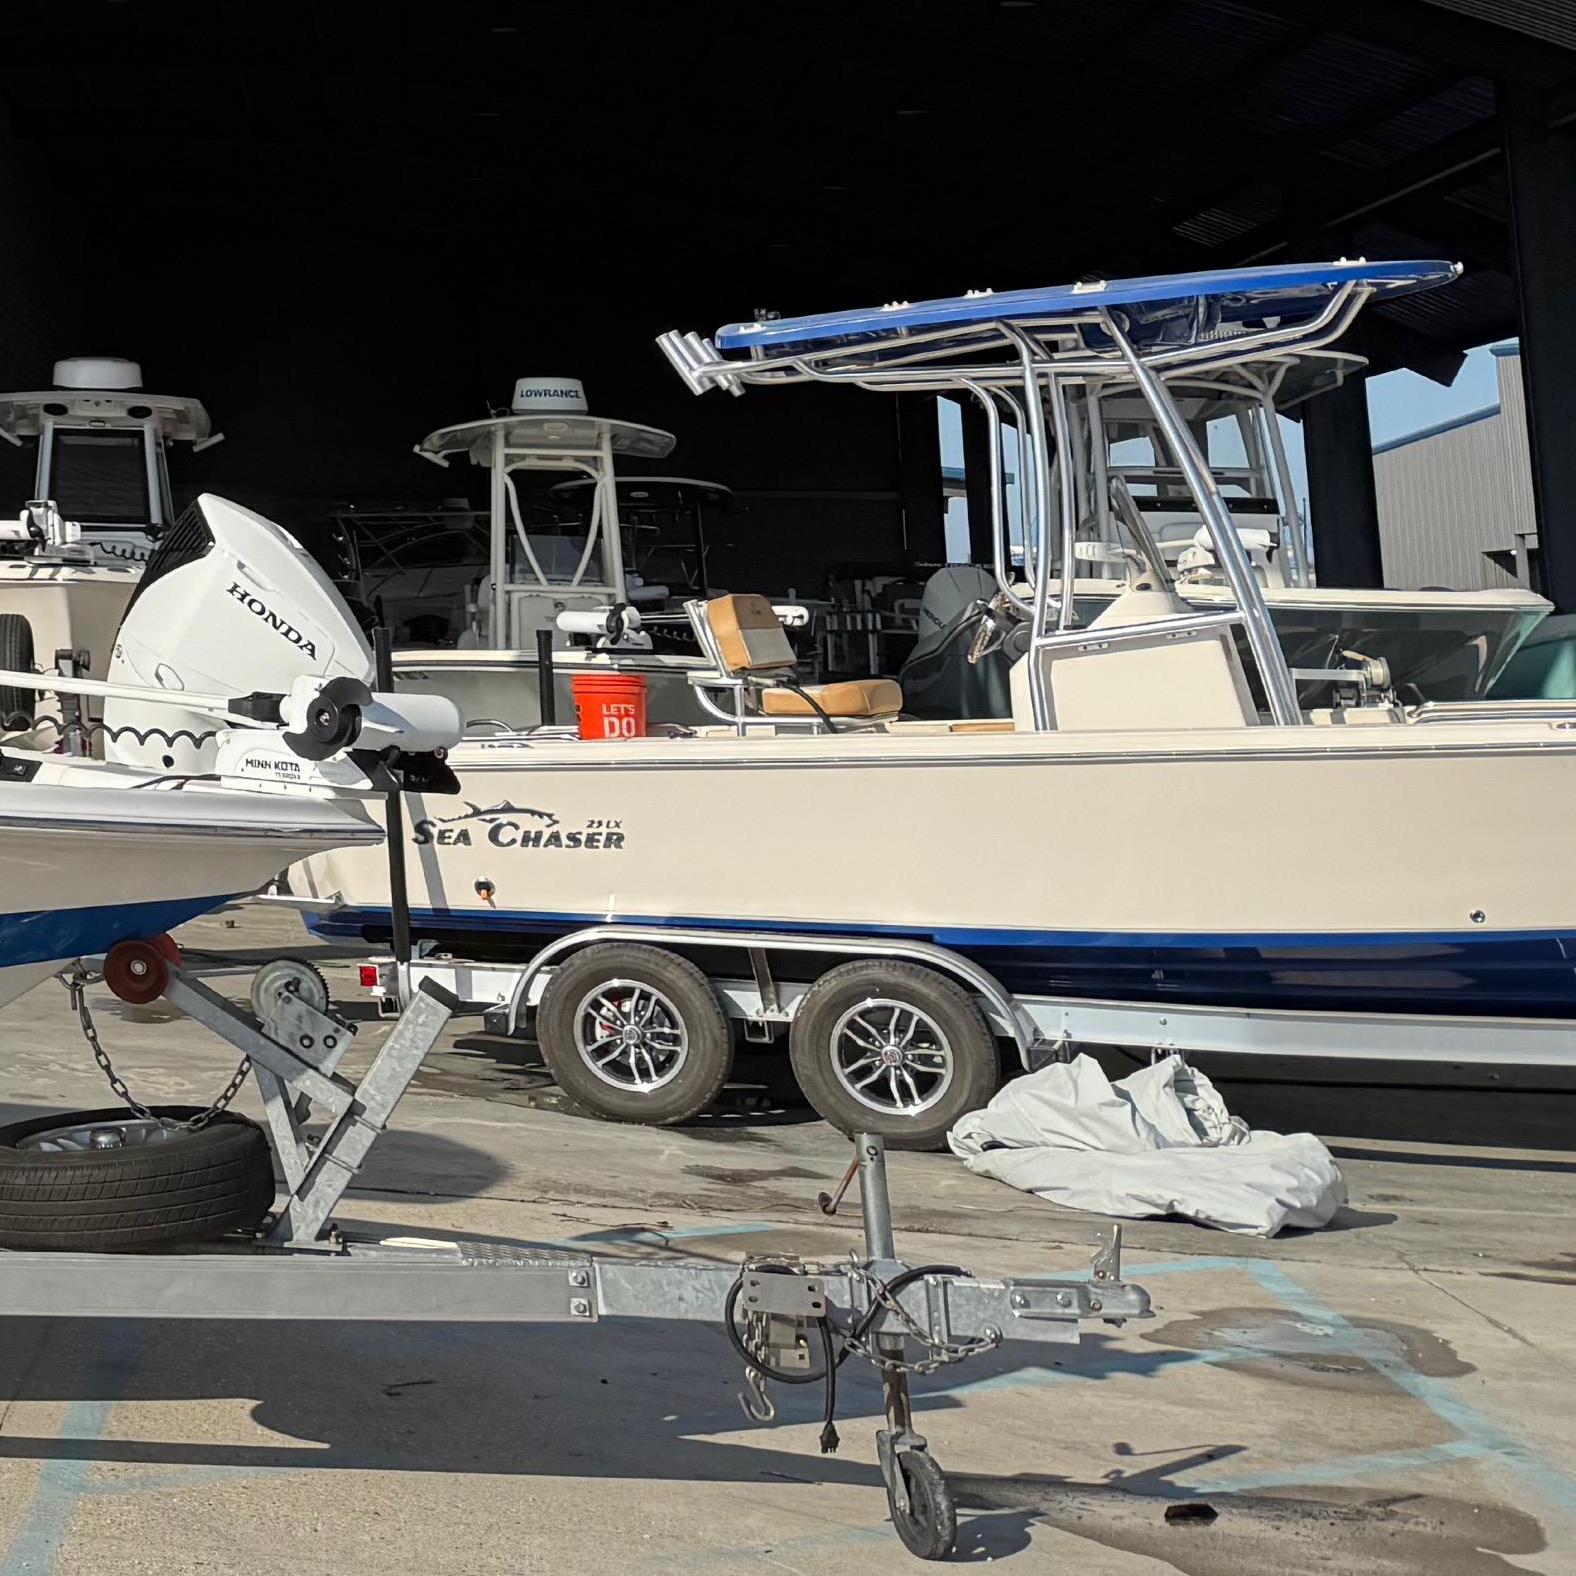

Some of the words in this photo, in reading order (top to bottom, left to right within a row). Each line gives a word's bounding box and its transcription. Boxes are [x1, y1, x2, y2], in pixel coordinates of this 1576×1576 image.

[520, 389, 582, 399] LOWRANCE
[226, 581, 317, 661] HONDA
[602, 703, 635, 715] LET'S
[603, 717, 636, 738] DO
[245, 758, 272, 769] MINN
[274, 761, 301, 772] KOTA
[411, 819, 472, 846] SEA
[487, 821, 626, 850] CHASER
